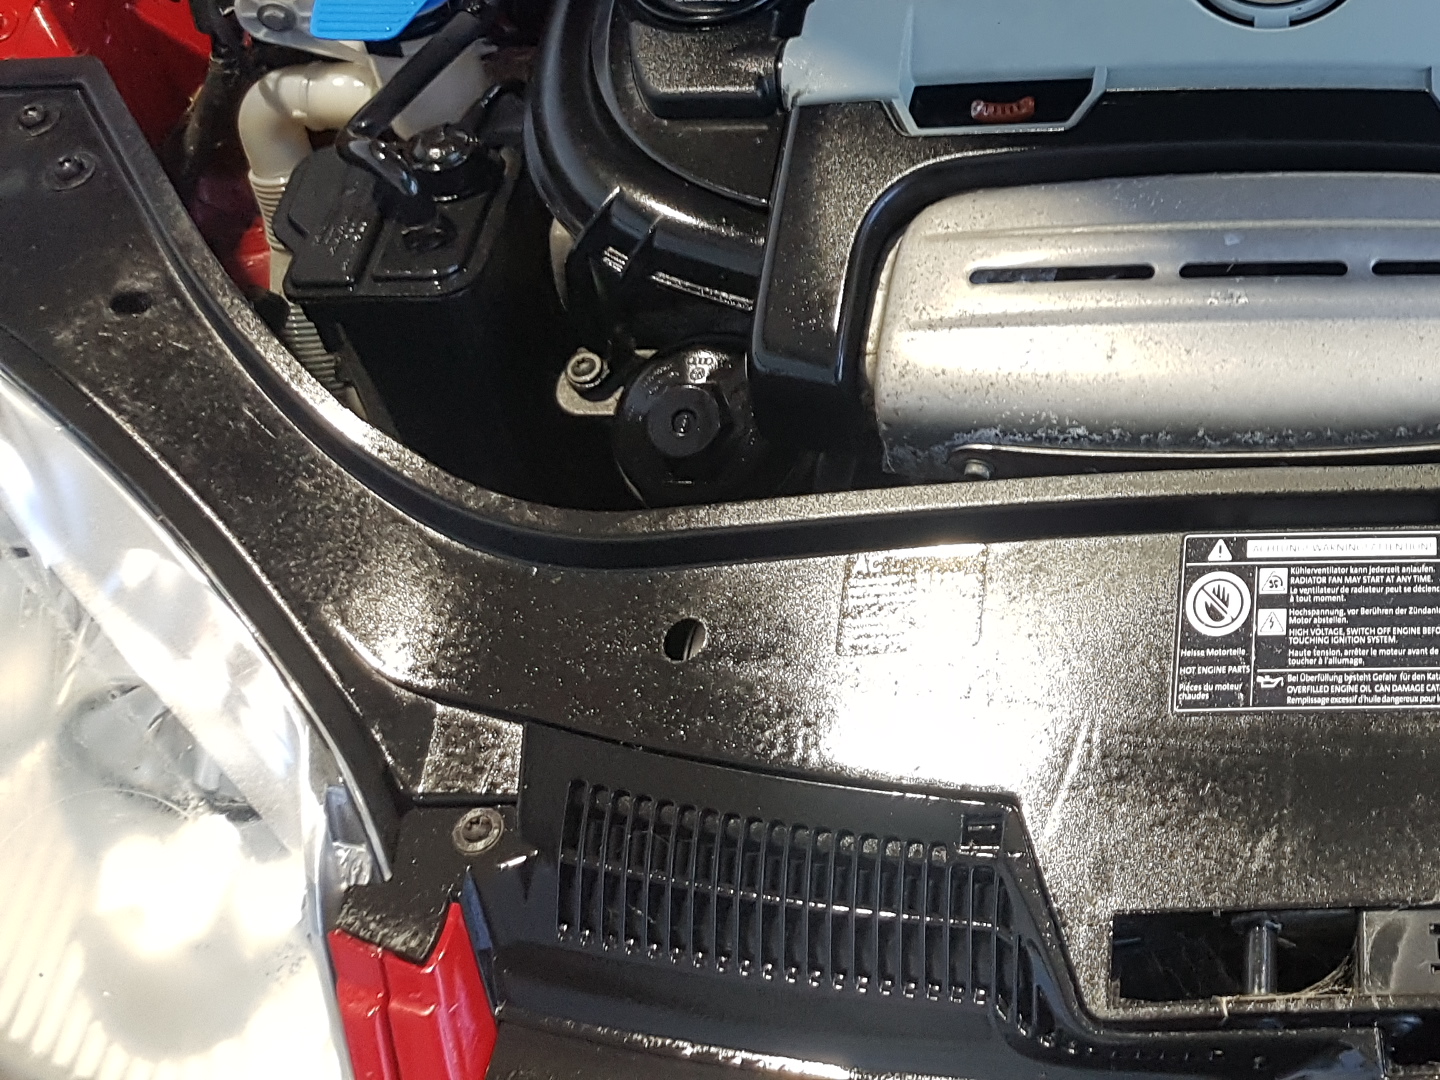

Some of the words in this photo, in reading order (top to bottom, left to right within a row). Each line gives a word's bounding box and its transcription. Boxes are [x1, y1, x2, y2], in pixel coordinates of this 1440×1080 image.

[1290, 566, 1348, 574] Kühlerventilator
[1350, 565, 1367, 574] kann
[1369, 565, 1400, 574] jederzeit
[1402, 564, 1435, 573] anlaufen.
[1290, 576, 1327, 584] RADIATOR
[1329, 576, 1343, 584] FAN
[1363, 575, 1384, 583] START
[1386, 575, 1394, 583] AT
[1396, 575, 1411, 583] ANY
[1413, 575, 1433, 583] TIME.
[1290, 586, 1298, 594] Le
[1300, 586, 1338, 594] ventilateur
[1340, 586, 1349, 594] de
[1351, 585, 1384, 593] radiateur
[1386, 585, 1402, 593] peut
[1404, 585, 1411, 593] se
[1347, 607, 1358, 616] vor
[1361, 607, 1393, 616] Berühren
[1395, 606, 1407, 616] der
[1289, 616, 1312, 624] Motor
[1313, 616, 1349, 624] abstellen.
[1289, 628, 1308, 636] HIGH
[1346, 627, 1375, 635] SWITCH
[1377, 627, 1391, 635] OFF
[1393, 626, 1421, 635] ENGINE
[1289, 637, 1329, 645] TOUCHING
[1331, 636, 1365, 644] IGNITION
[1367, 636, 1398, 644] SYSTEM.
[1289, 649, 1311, 657] Haute
[1344, 648, 1369, 656] arrêter
[1371, 648, 1377, 656] le
[1408, 647, 1428, 655] avant
[1430, 647, 1439, 655] de
[1288, 657, 1317, 666] toucher
[1179, 666, 1196, 674] HOT
[1198, 666, 1226, 674] ENGINE
[1228, 665, 1250, 673] PARTS
[1288, 674, 1298, 682] Bei
[1300, 673, 1342, 682] Überfüllung
[1344, 673, 1371, 682] besteht
[1373, 672, 1397, 682] Gefahr
[1400, 672, 1410, 681] für
[1412, 672, 1425, 681] den
[1204, 683, 1213, 691] du
[1215, 683, 1242, 691] moteur
[1287, 684, 1329, 693] OVERFILLED
[1331, 684, 1358, 692] ENGINE
[1360, 684, 1371, 692] OIL
[1375, 684, 1390, 692] CAN
[1392, 683, 1425, 692] DAMAGE
[1287, 696, 1330, 704] Remplissage
[1331, 695, 1357, 704] excessif
[1358, 695, 1381, 704] d'huile
[1382, 694, 1418, 704] dangereux
[1420, 694, 1436, 703] pour
